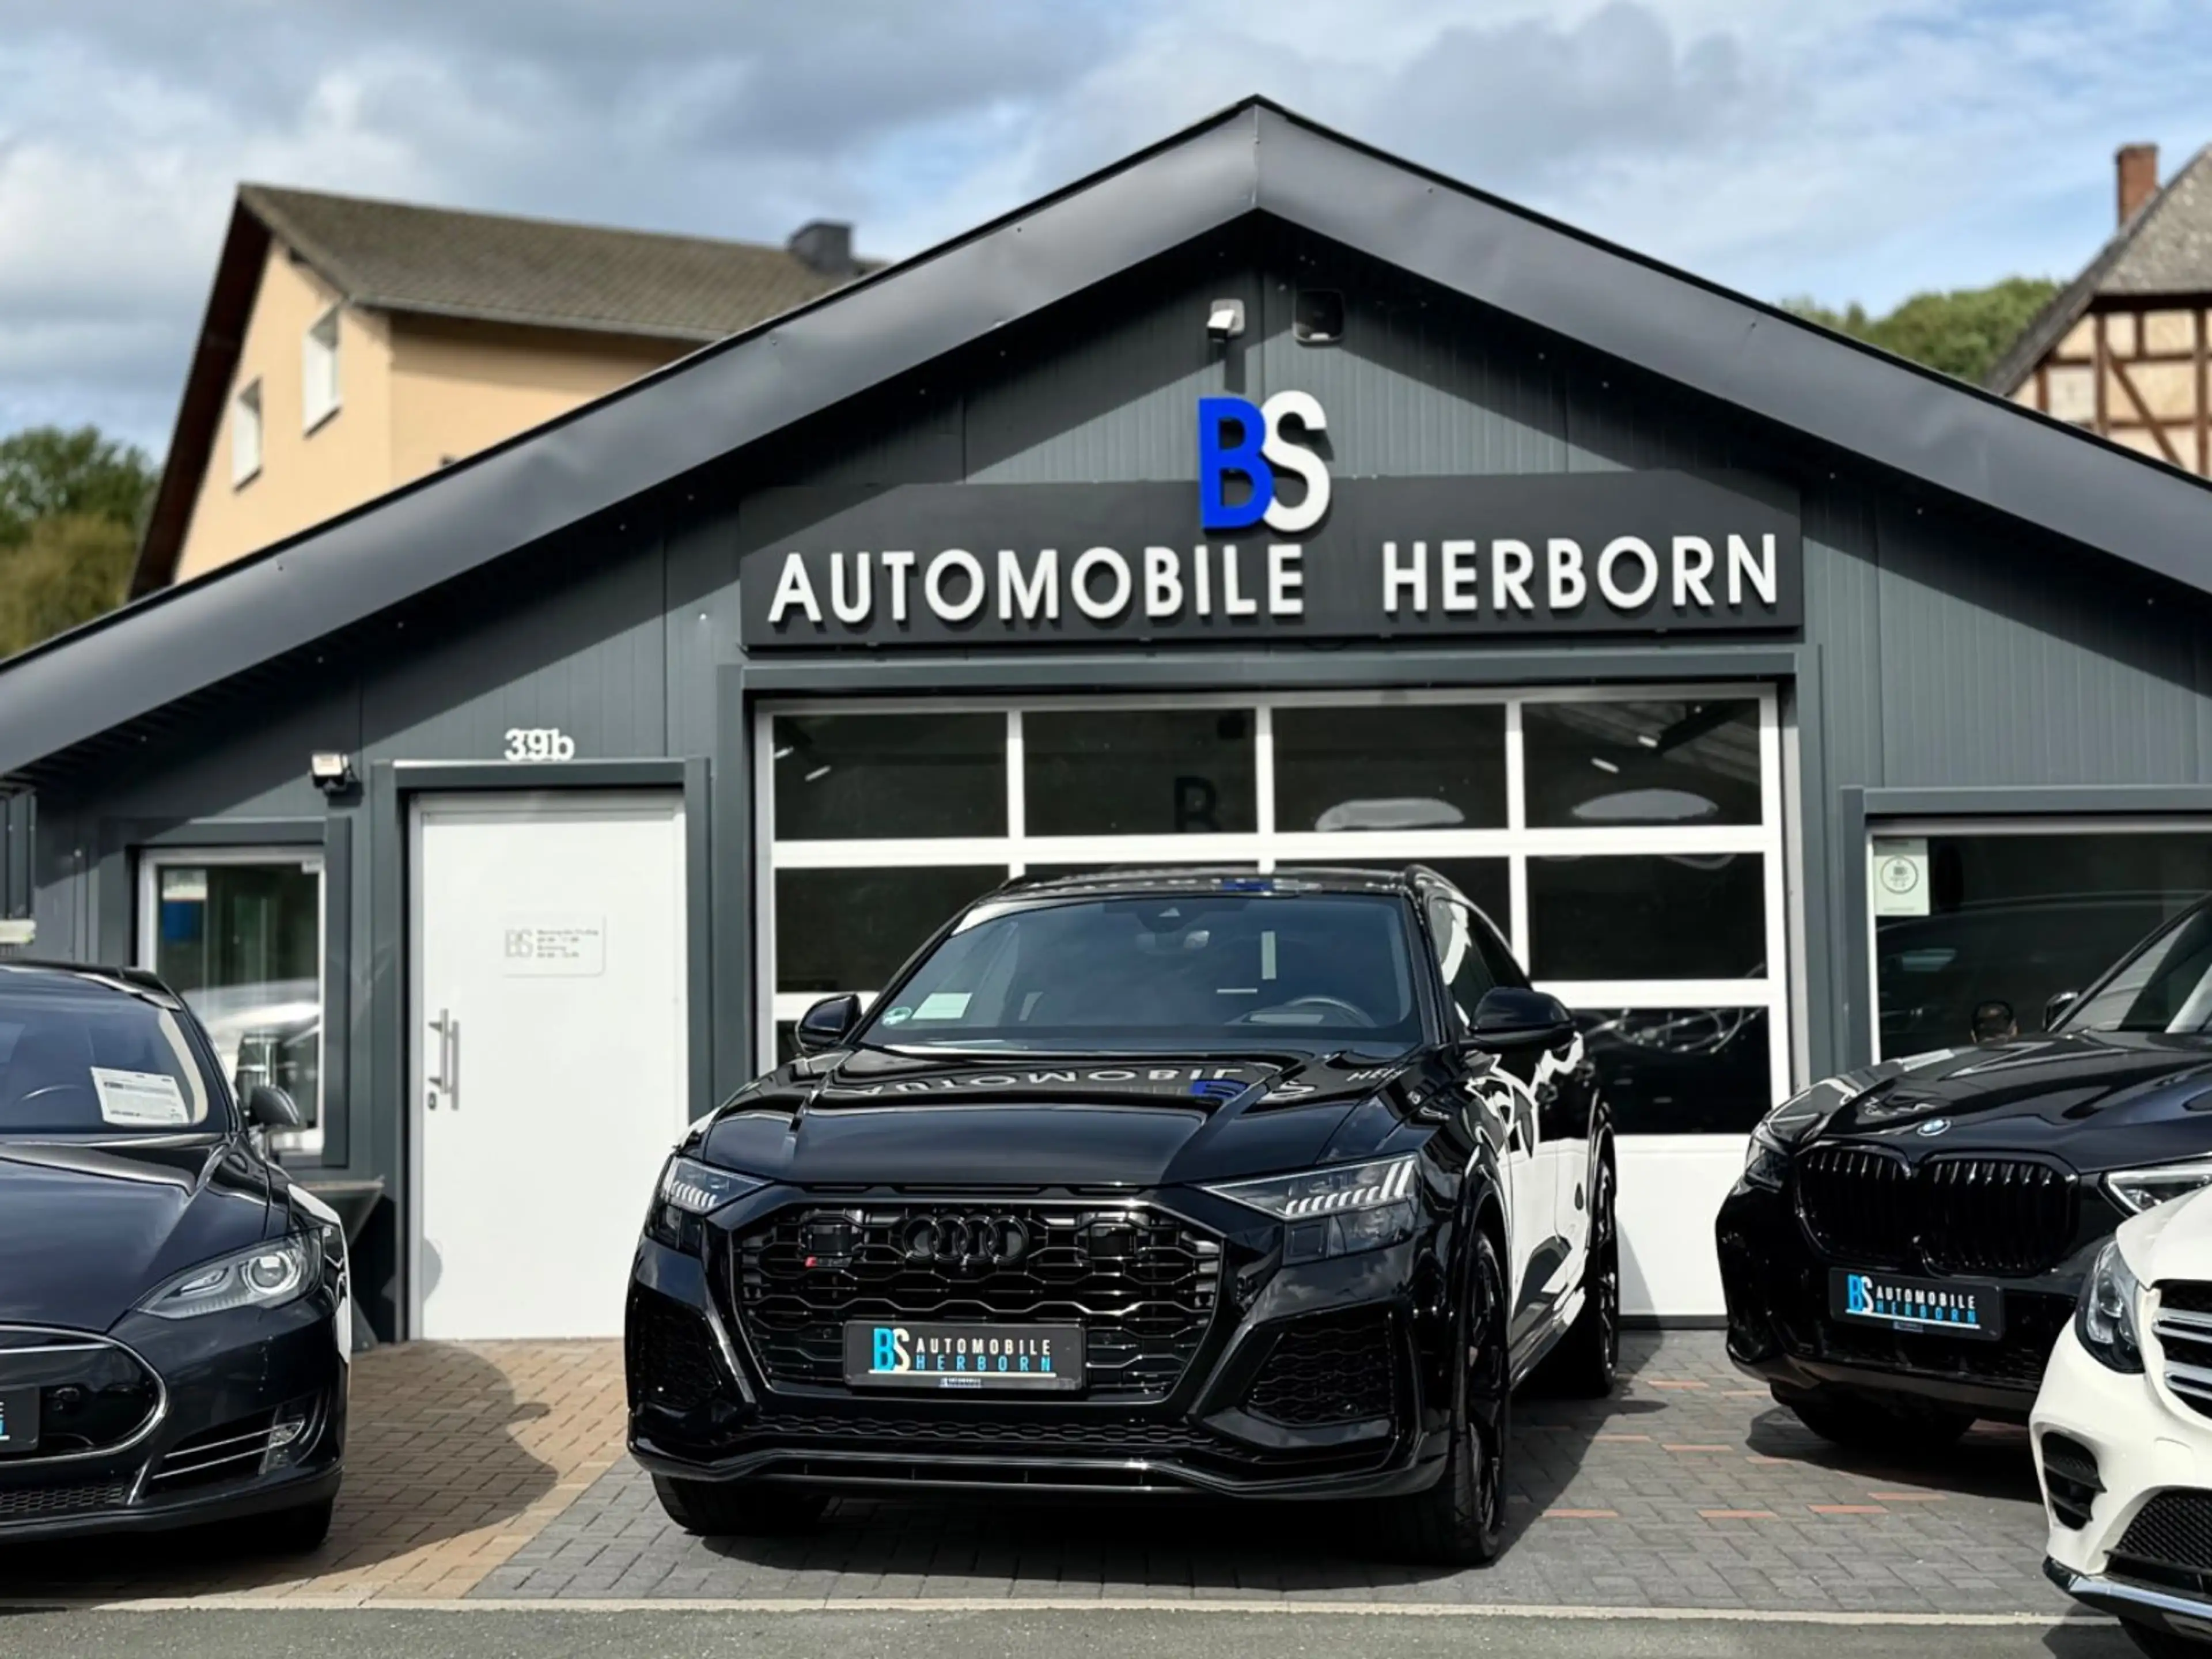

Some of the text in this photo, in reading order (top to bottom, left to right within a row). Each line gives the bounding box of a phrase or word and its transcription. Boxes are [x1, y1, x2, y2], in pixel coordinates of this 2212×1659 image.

[1198, 390, 1331, 532] BS
[768, 533, 1777, 623] AUTOMOBILE HERBORN
[504, 728, 575, 762] 39b
[1847, 1274, 1976, 1314] BS AUTOMOBILE
[873, 1327, 1051, 1372] BS AUTOMOBILE
[915, 1354, 1051, 1372] HERBORN
